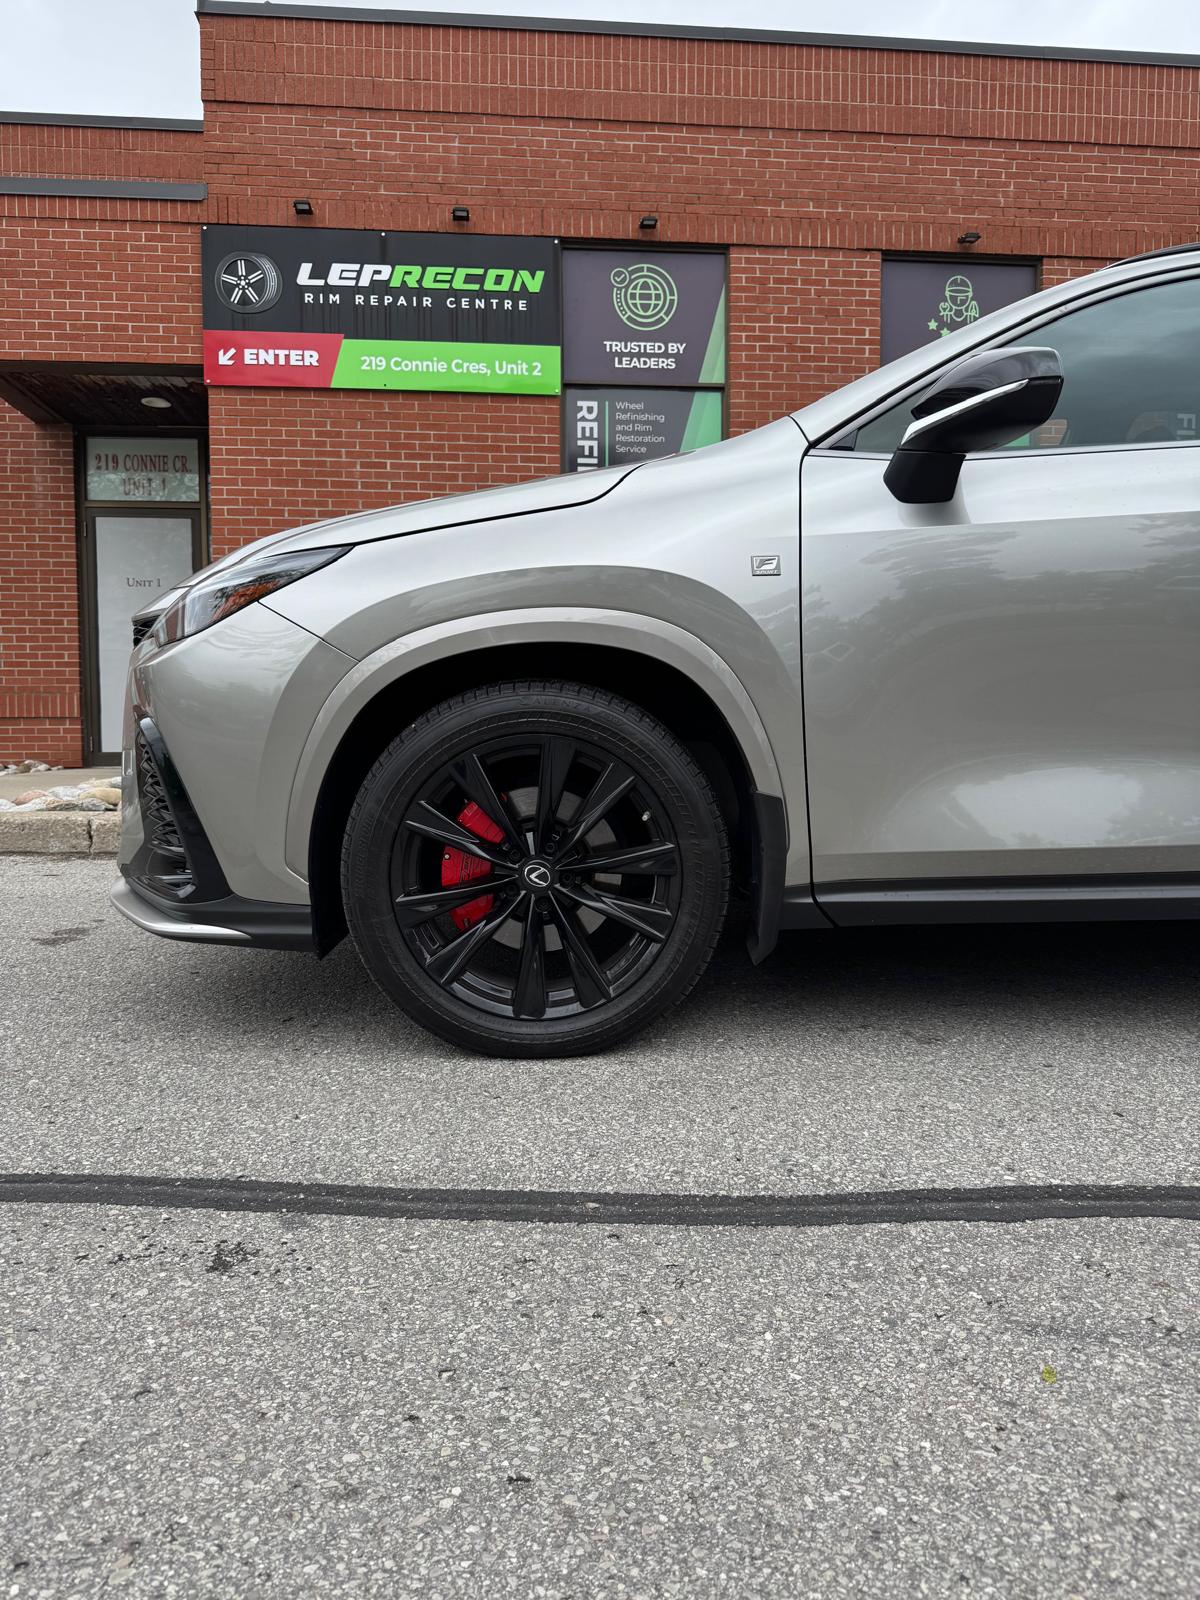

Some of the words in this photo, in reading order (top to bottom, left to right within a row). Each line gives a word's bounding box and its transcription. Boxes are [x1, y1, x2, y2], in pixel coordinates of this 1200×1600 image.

[296, 262, 545, 293] LEPRECON
[304, 293, 341, 305] RIM
[355, 295, 432, 308] REPAIR
[446, 298, 528, 311] CENTRE
[603, 341, 665, 354] TRUSTED
[668, 343, 686, 354] BY
[244, 348, 319, 366] ENTER
[614, 357, 676, 369] LEADERS
[360, 356, 386, 371] 219
[390, 357, 448, 373] Connie
[451, 359, 491, 376] Cres,
[495, 361, 529, 375] Unit
[532, 362, 542, 376] 2
[615, 401, 644, 410] Wheel
[615, 412, 665, 423] Refinishing
[615, 423, 632, 432] and
[634, 423, 652, 431] Rim
[615, 434, 665, 443] Restoration
[615, 445, 647, 453] Service
[95, 453, 119, 470] 219
[123, 454, 168, 473] CONNIE
[173, 455, 192, 473] CR.
[157, 577, 161, 587] 1
